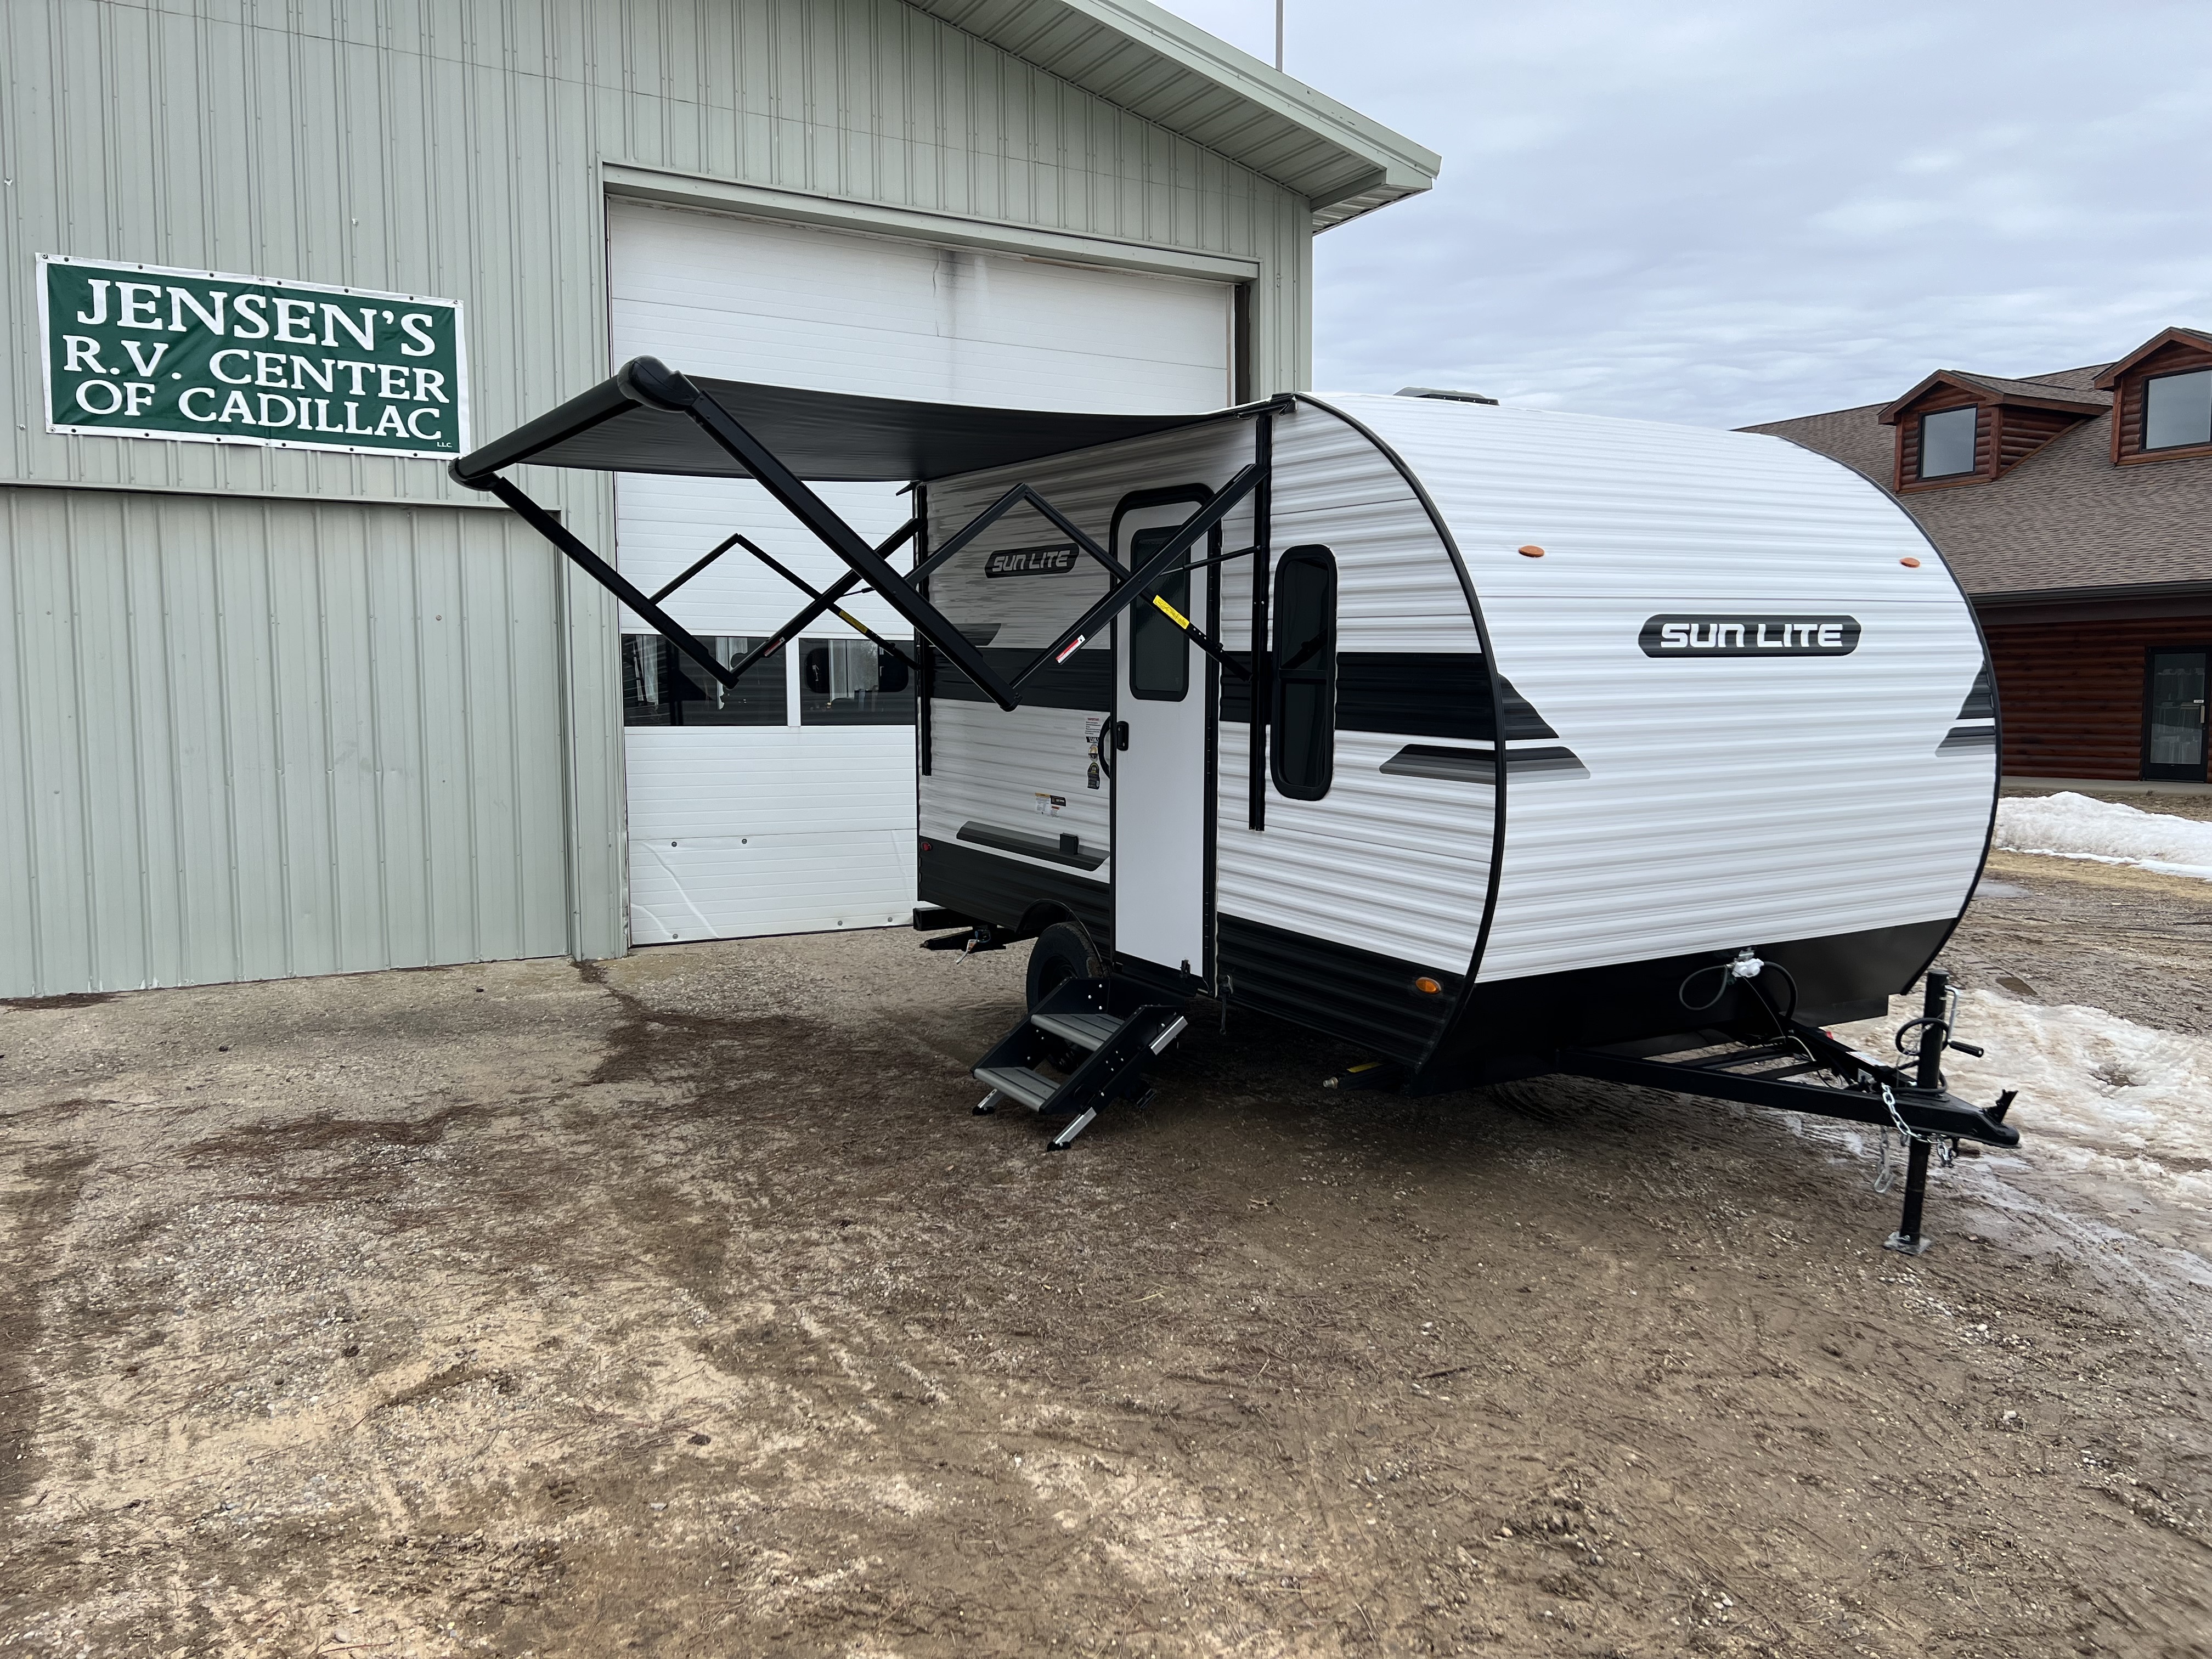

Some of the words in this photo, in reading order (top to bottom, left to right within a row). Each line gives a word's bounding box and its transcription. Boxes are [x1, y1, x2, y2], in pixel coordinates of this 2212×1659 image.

[77, 279, 435, 357] JENSEN'S
[63, 335, 182, 380] R.V.
[210, 349, 450, 403] CENTER
[76, 379, 155, 416] OF
[179, 387, 442, 440] CADILLAC
[992, 554, 1026, 572] SUN
[1029, 550, 1070, 569] LITE
[1661, 623, 1745, 648] SUN
[1757, 623, 1843, 647] LITE
